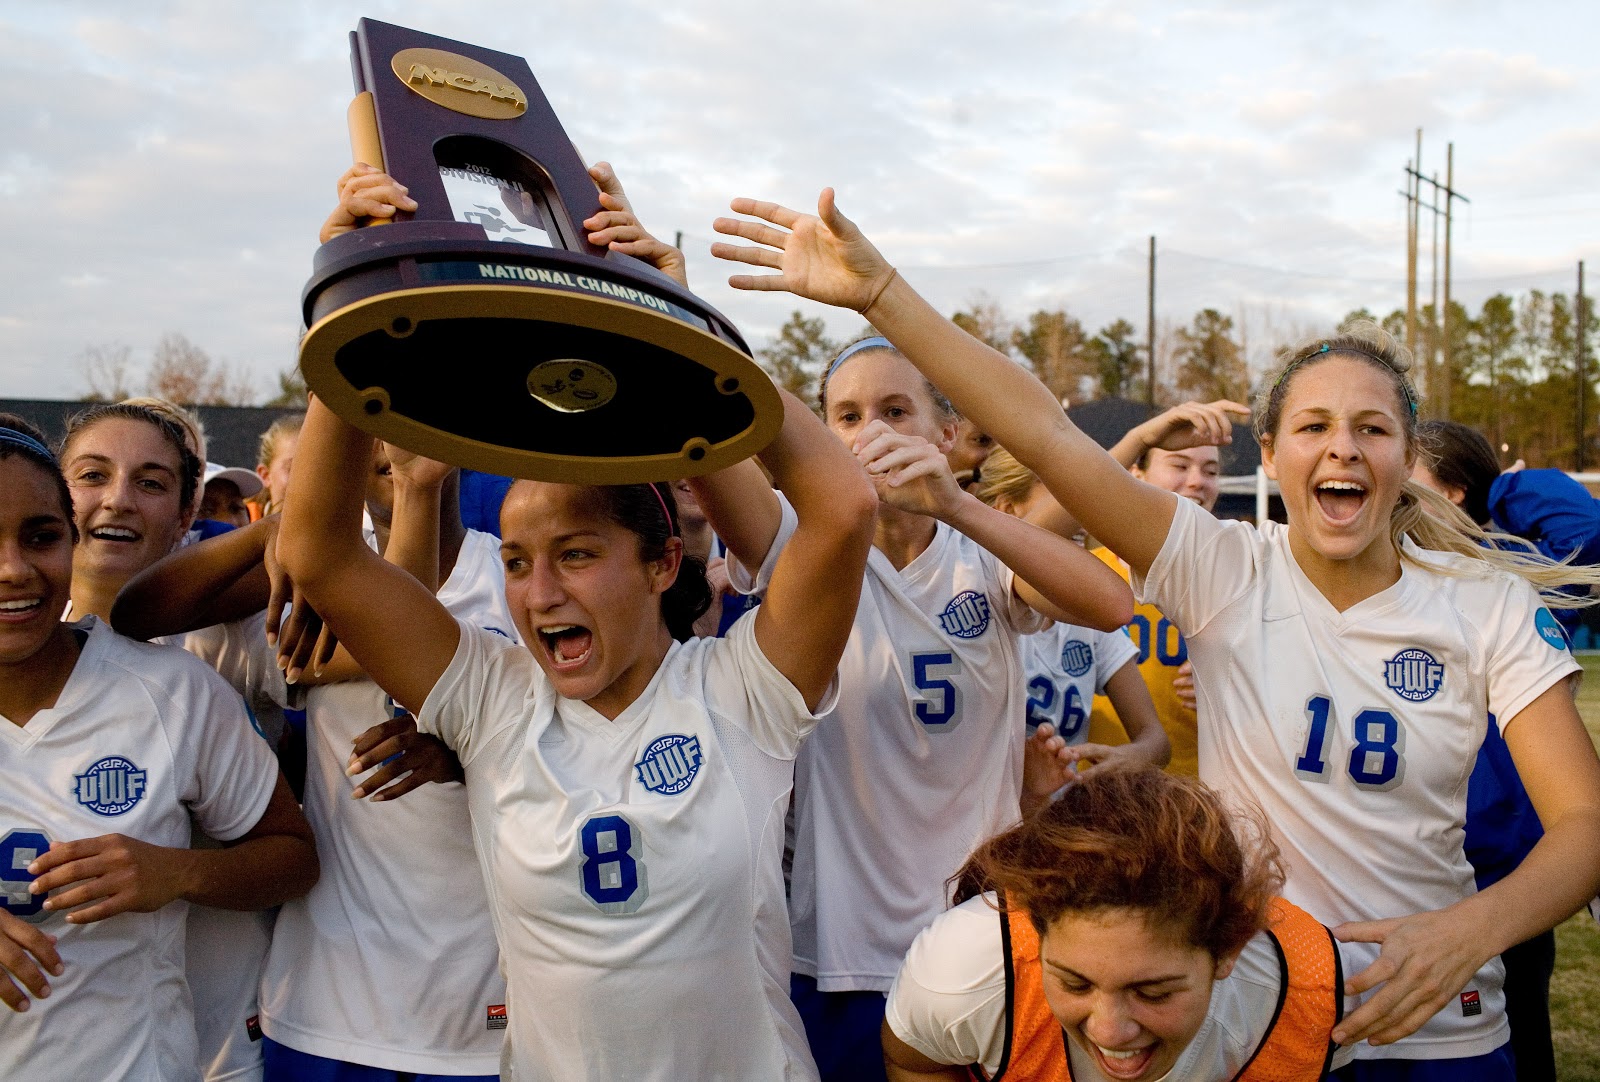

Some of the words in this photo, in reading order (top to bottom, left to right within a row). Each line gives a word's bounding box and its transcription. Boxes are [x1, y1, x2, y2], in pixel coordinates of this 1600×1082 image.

[408, 63, 525, 111] NCAA
[438, 165, 511, 192] DIVISION
[464, 162, 493, 176] 2012
[478, 263, 577, 288] NATIONAL
[576, 276, 670, 313] CHAMPION
[940, 596, 988, 634] UWF
[1062, 646, 1091, 671] UWF
[1387, 659, 1443, 692] UWF
[911, 652, 959, 728] 5
[1026, 676, 1087, 738] 26
[639, 738, 700, 789] UWF
[1295, 694, 1402, 788] 18
[78, 768, 146, 805] UWF
[579, 813, 645, 909] 8
